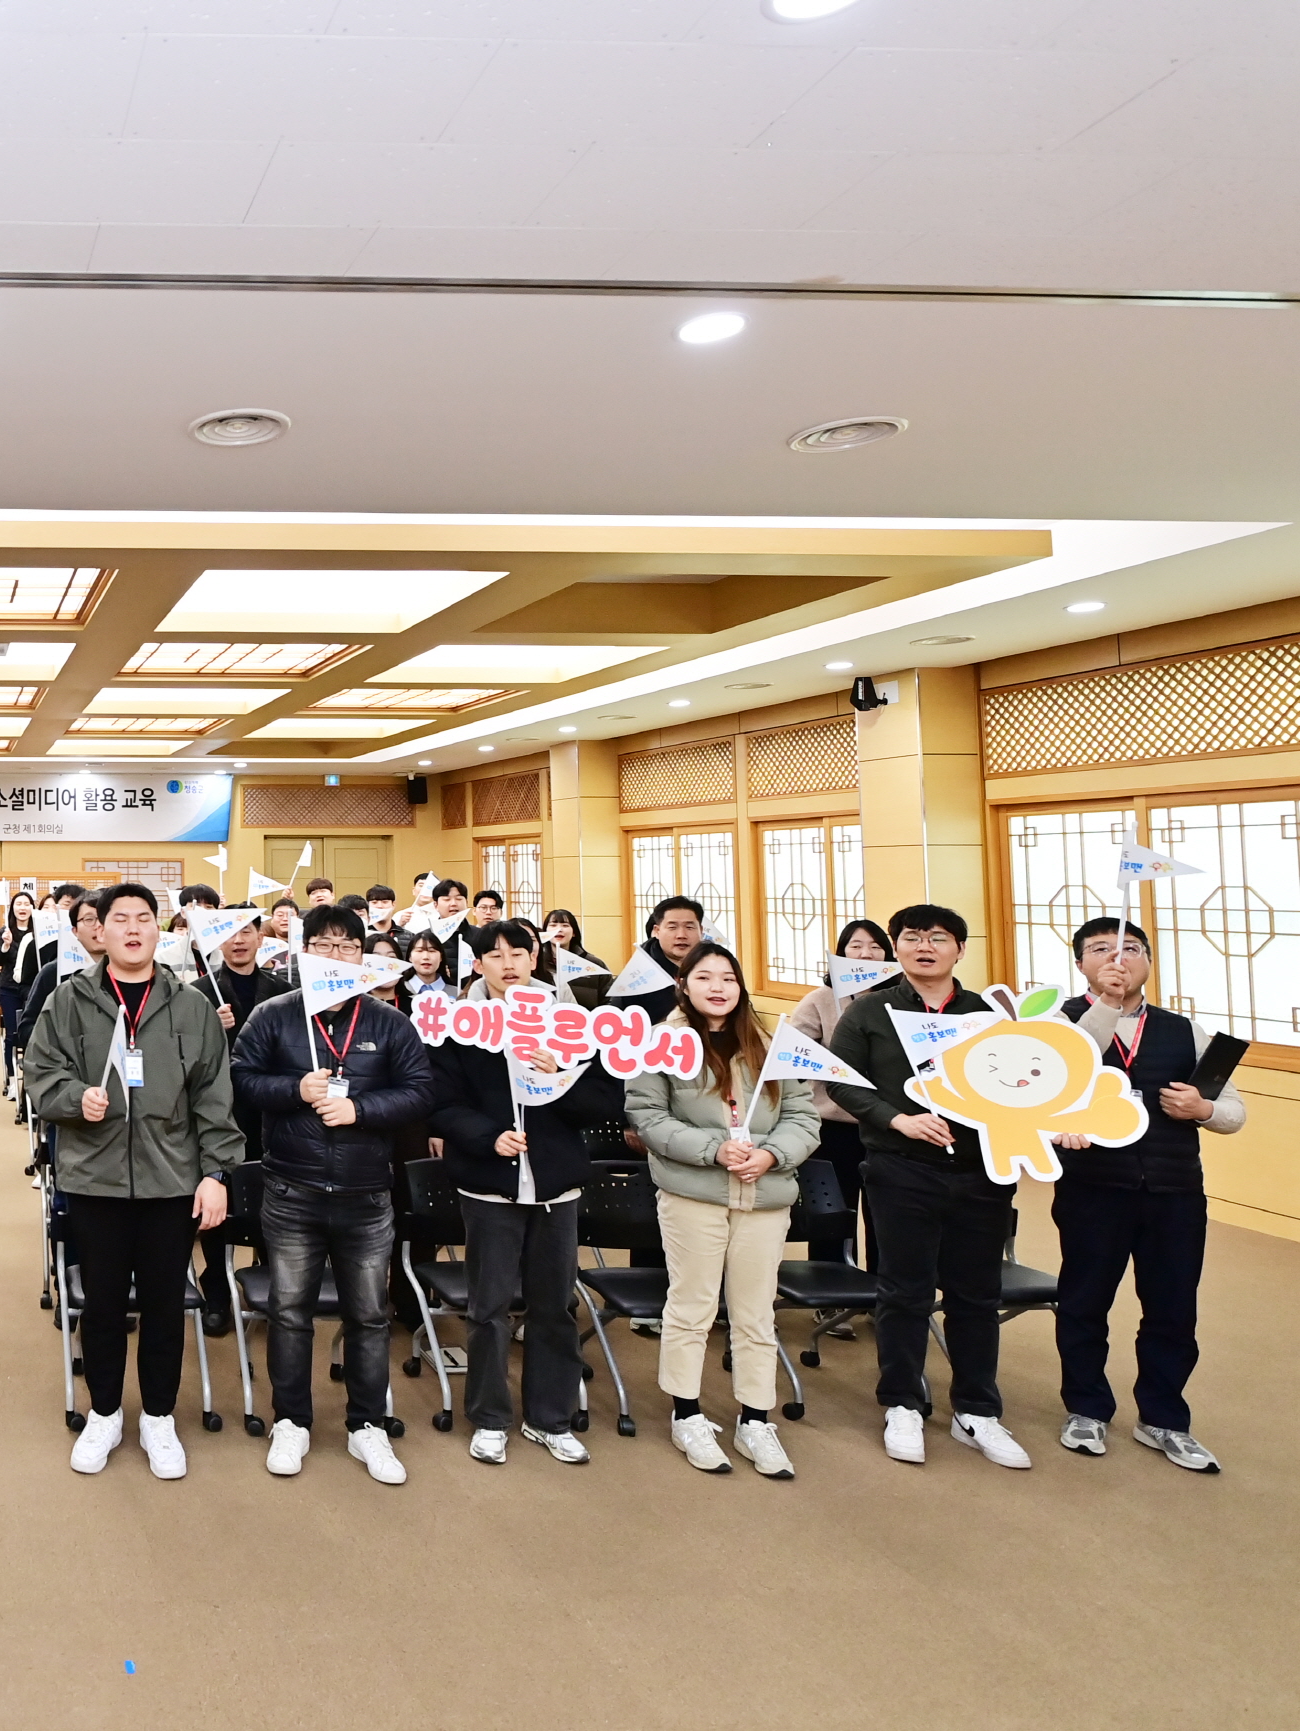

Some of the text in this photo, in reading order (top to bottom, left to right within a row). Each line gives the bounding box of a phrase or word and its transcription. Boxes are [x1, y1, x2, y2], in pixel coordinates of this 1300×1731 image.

[83, 788, 118, 812] 활용
[122, 788, 157, 812] 교육
[3, 824, 20, 834] 군청
[23, 824, 64, 834] 제1회의실
[22, 882, 33, 890] 체
[327, 979, 355, 992] 홍보맨
[418, 991, 696, 1073] #애플루언서
[927, 1028, 957, 1042] 홍보맨
[792, 1055, 823, 1072] 홍보맨
